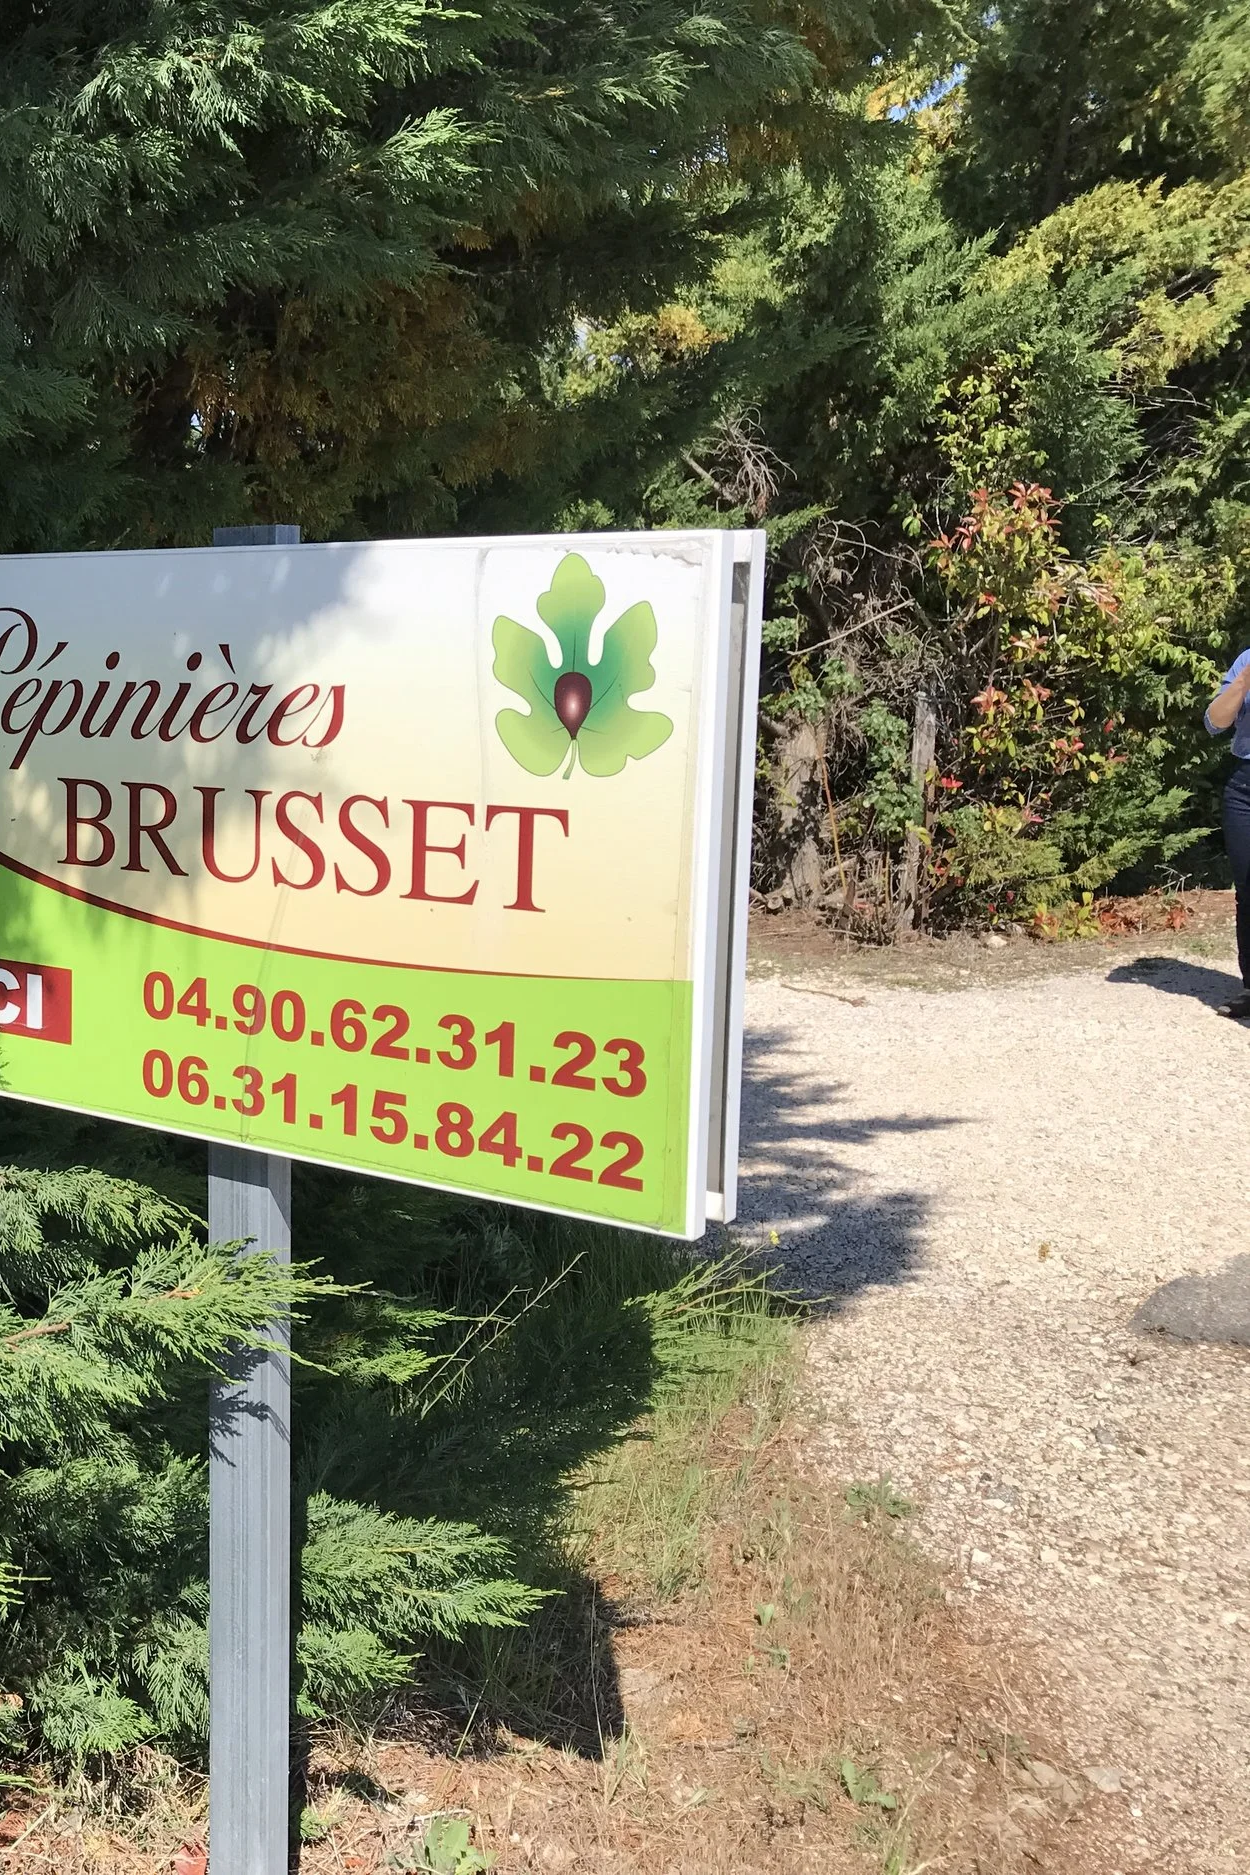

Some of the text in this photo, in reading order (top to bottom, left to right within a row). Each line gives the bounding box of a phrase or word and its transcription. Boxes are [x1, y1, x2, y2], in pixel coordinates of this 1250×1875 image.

[58, 778, 569, 912] BRUSSET
[143, 971, 646, 1097] 04.90.62.31.23
[143, 1050, 644, 1191] 06.31.15.84.22
